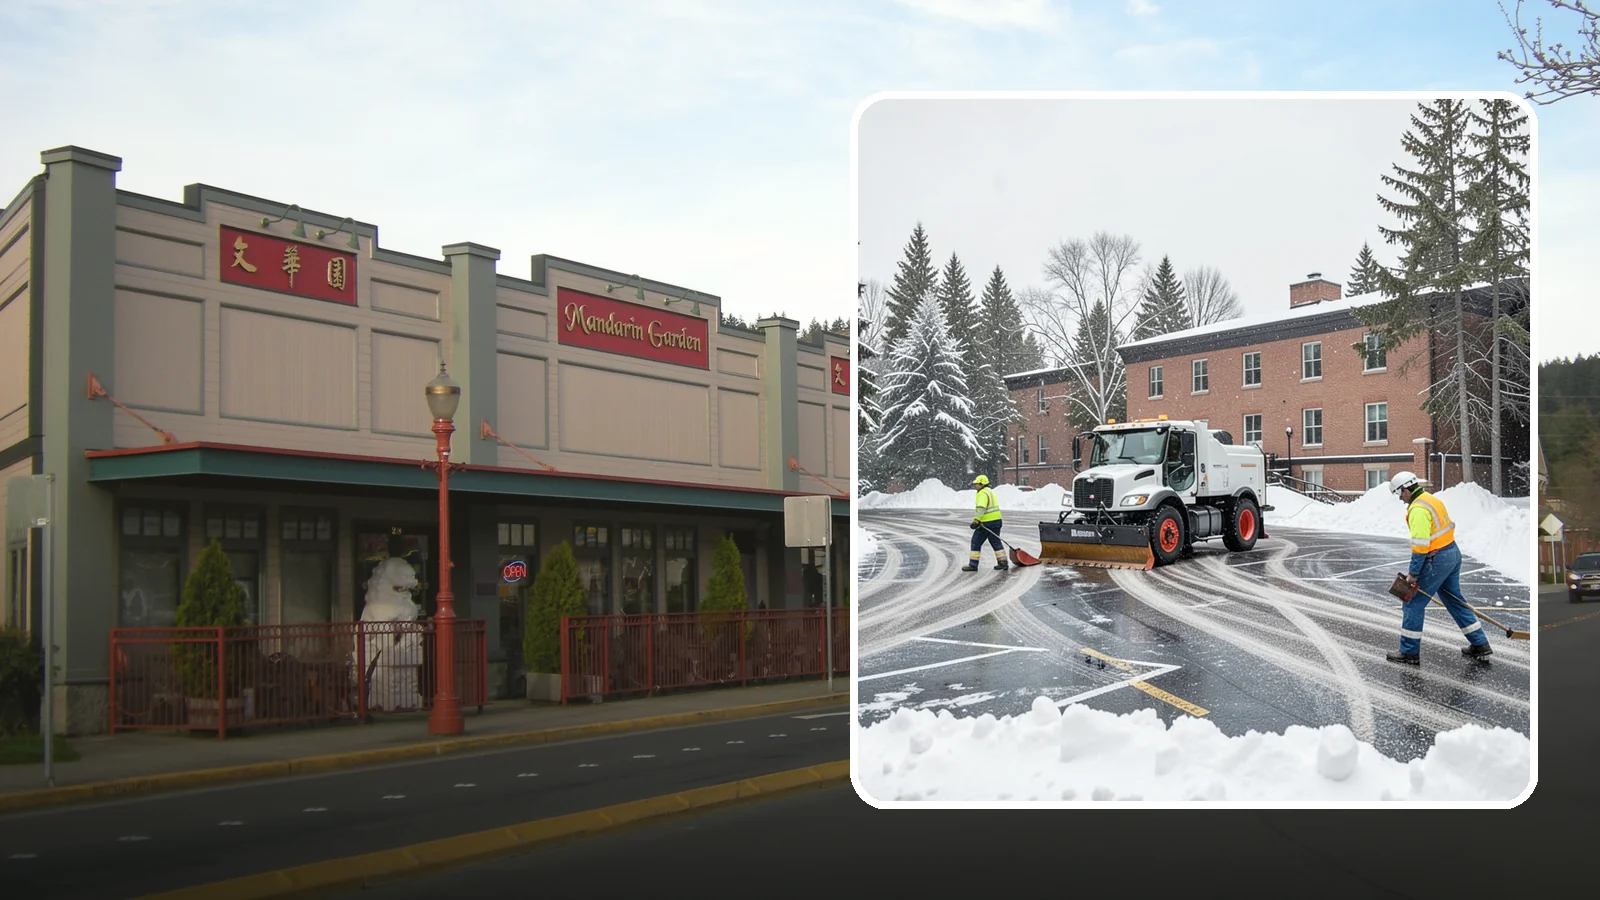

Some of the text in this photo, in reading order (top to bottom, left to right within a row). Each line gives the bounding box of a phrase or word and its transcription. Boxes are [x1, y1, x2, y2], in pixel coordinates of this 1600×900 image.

[230, 235, 347, 291] 文華園
[564, 302, 702, 352] Mandarin Garden
[502, 565, 527, 578] OPEN
